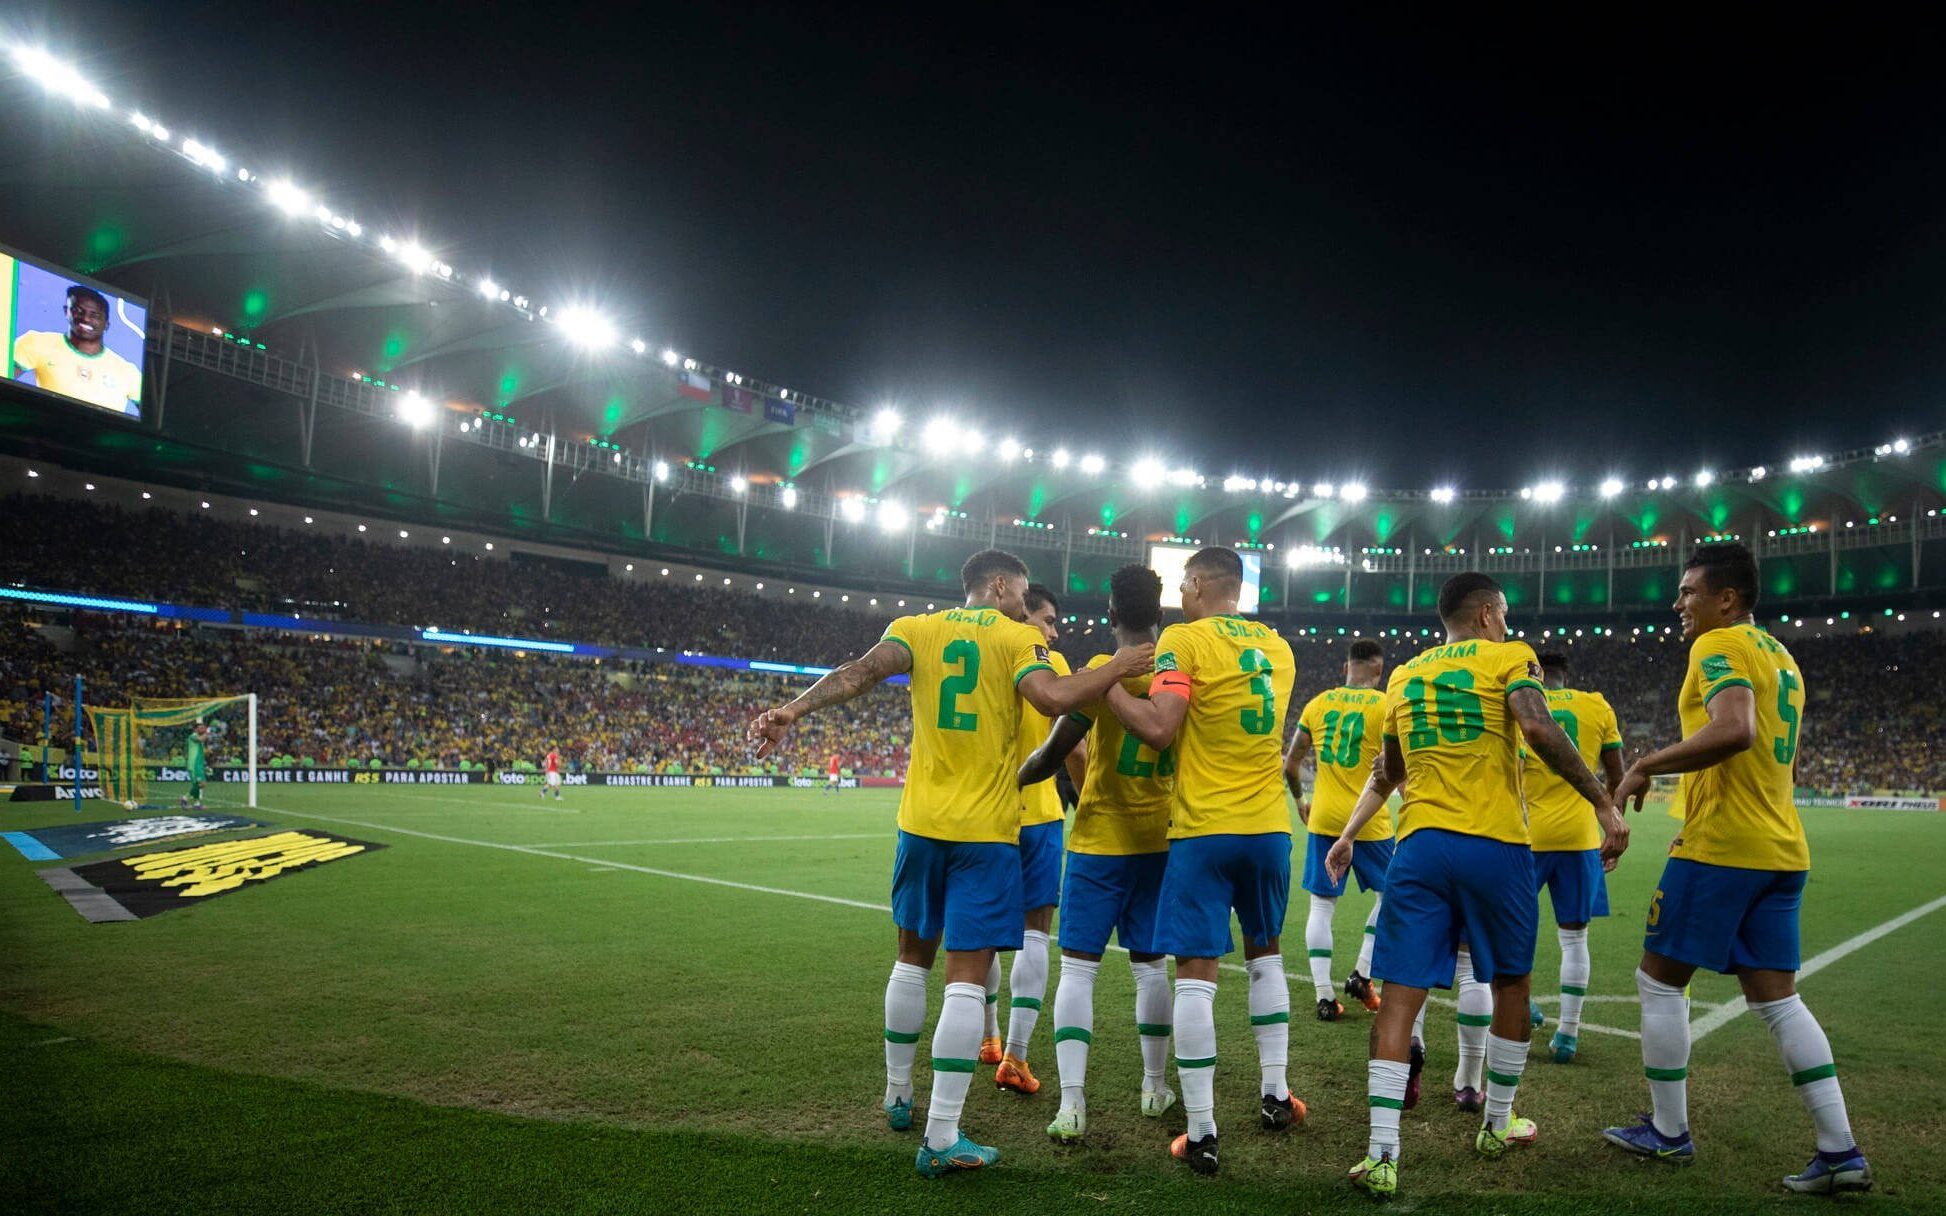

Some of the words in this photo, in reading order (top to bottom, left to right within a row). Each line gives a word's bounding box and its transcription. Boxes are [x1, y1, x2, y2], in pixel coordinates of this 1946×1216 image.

[1225, 619, 1266, 638] SILA
[1421, 642, 1477, 664] ARANA
[937, 639, 980, 731] 2
[1239, 648, 1275, 735] 3
[1404, 669, 1484, 750] 16
[1320, 710, 1365, 768] 10
[1774, 668, 1799, 765] 5
[296, 771, 303, 783] E
[307, 771, 349, 783] GANHE
[385, 772, 414, 784] PARA
[419, 773, 469, 785] APOSTAR
[606, 775, 651, 786] CADASTRE
[663, 776, 691, 787] GANHE
[715, 777, 735, 787] PARA
